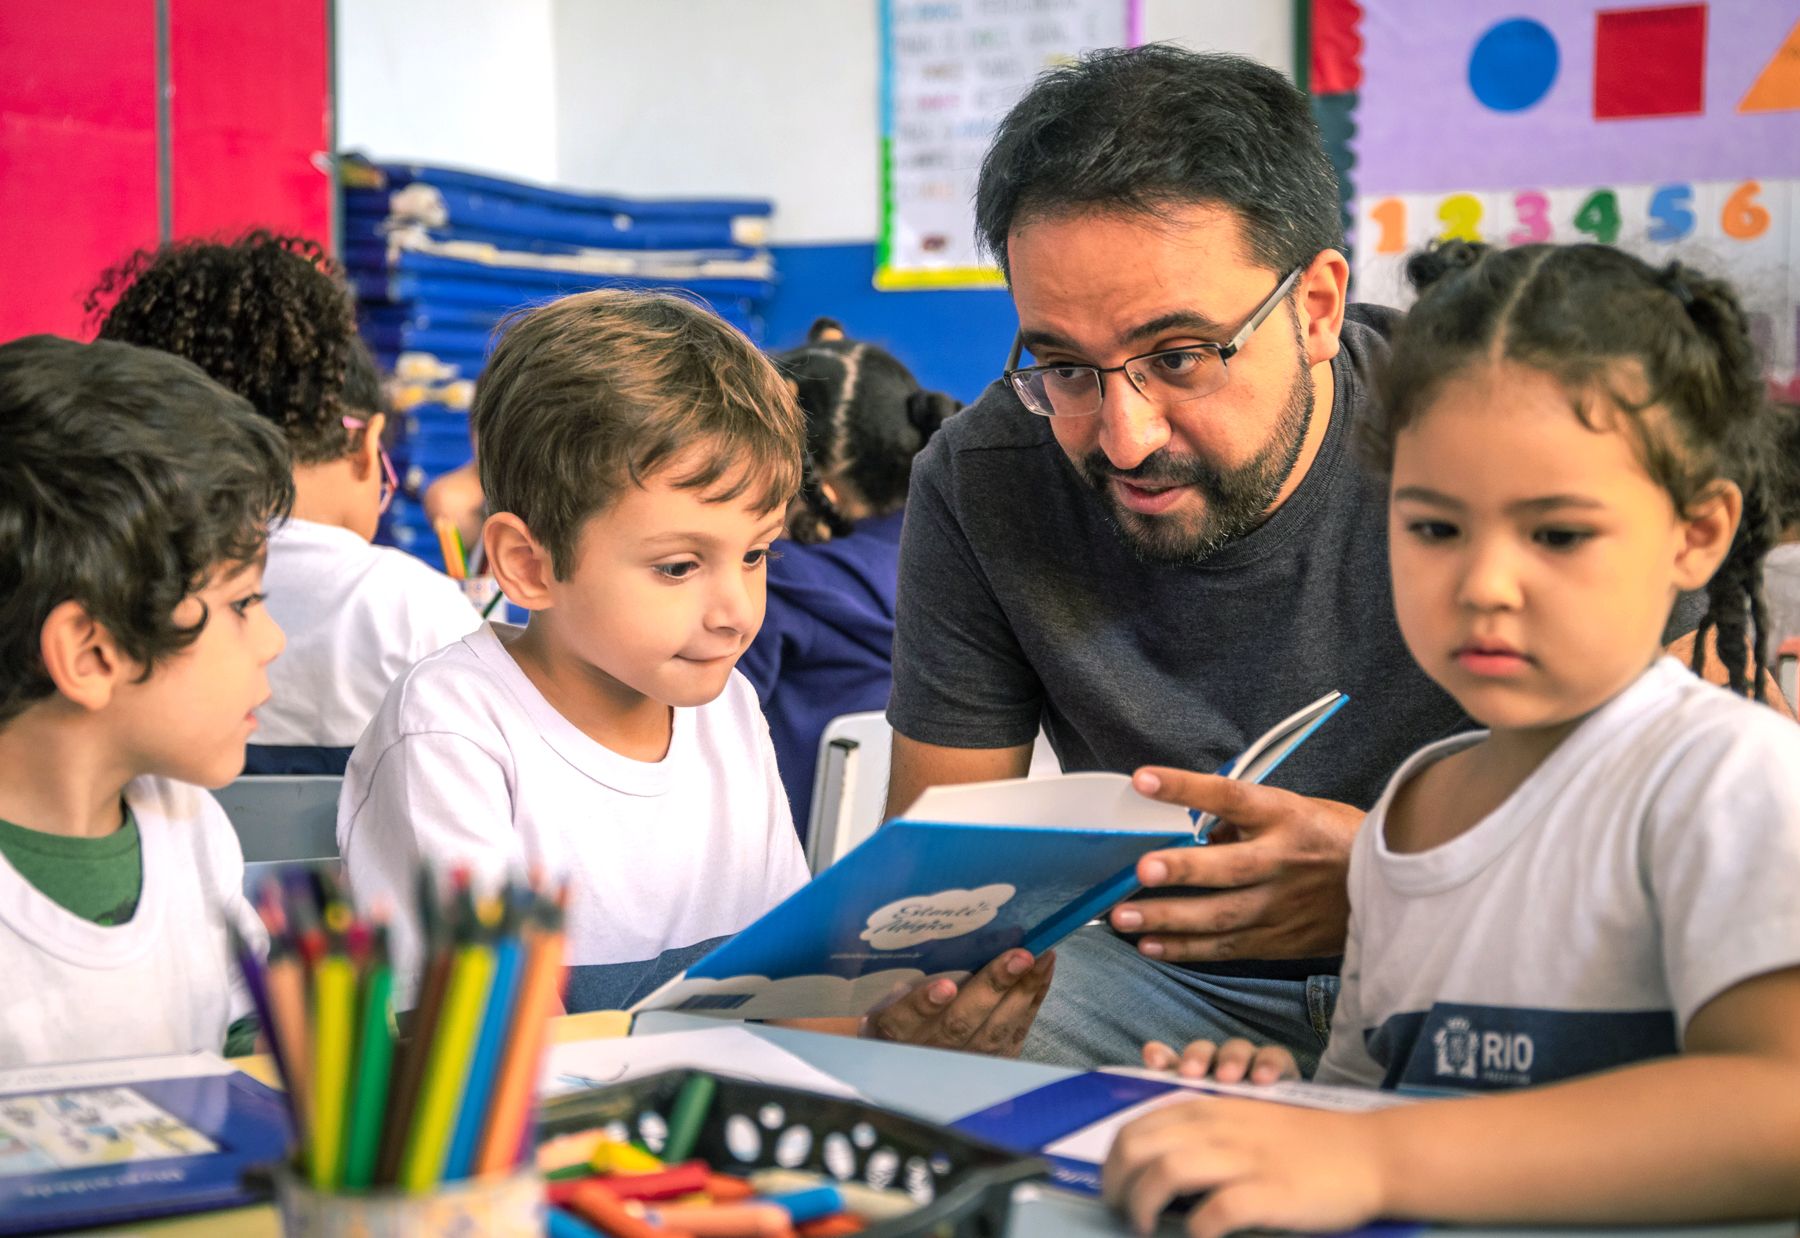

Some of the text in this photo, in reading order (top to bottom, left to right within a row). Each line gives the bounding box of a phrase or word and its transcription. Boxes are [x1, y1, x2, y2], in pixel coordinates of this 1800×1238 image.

[1370, 180, 1771, 254] 1 2 3 4 5 6
[1482, 1031, 1534, 1073] RIO
